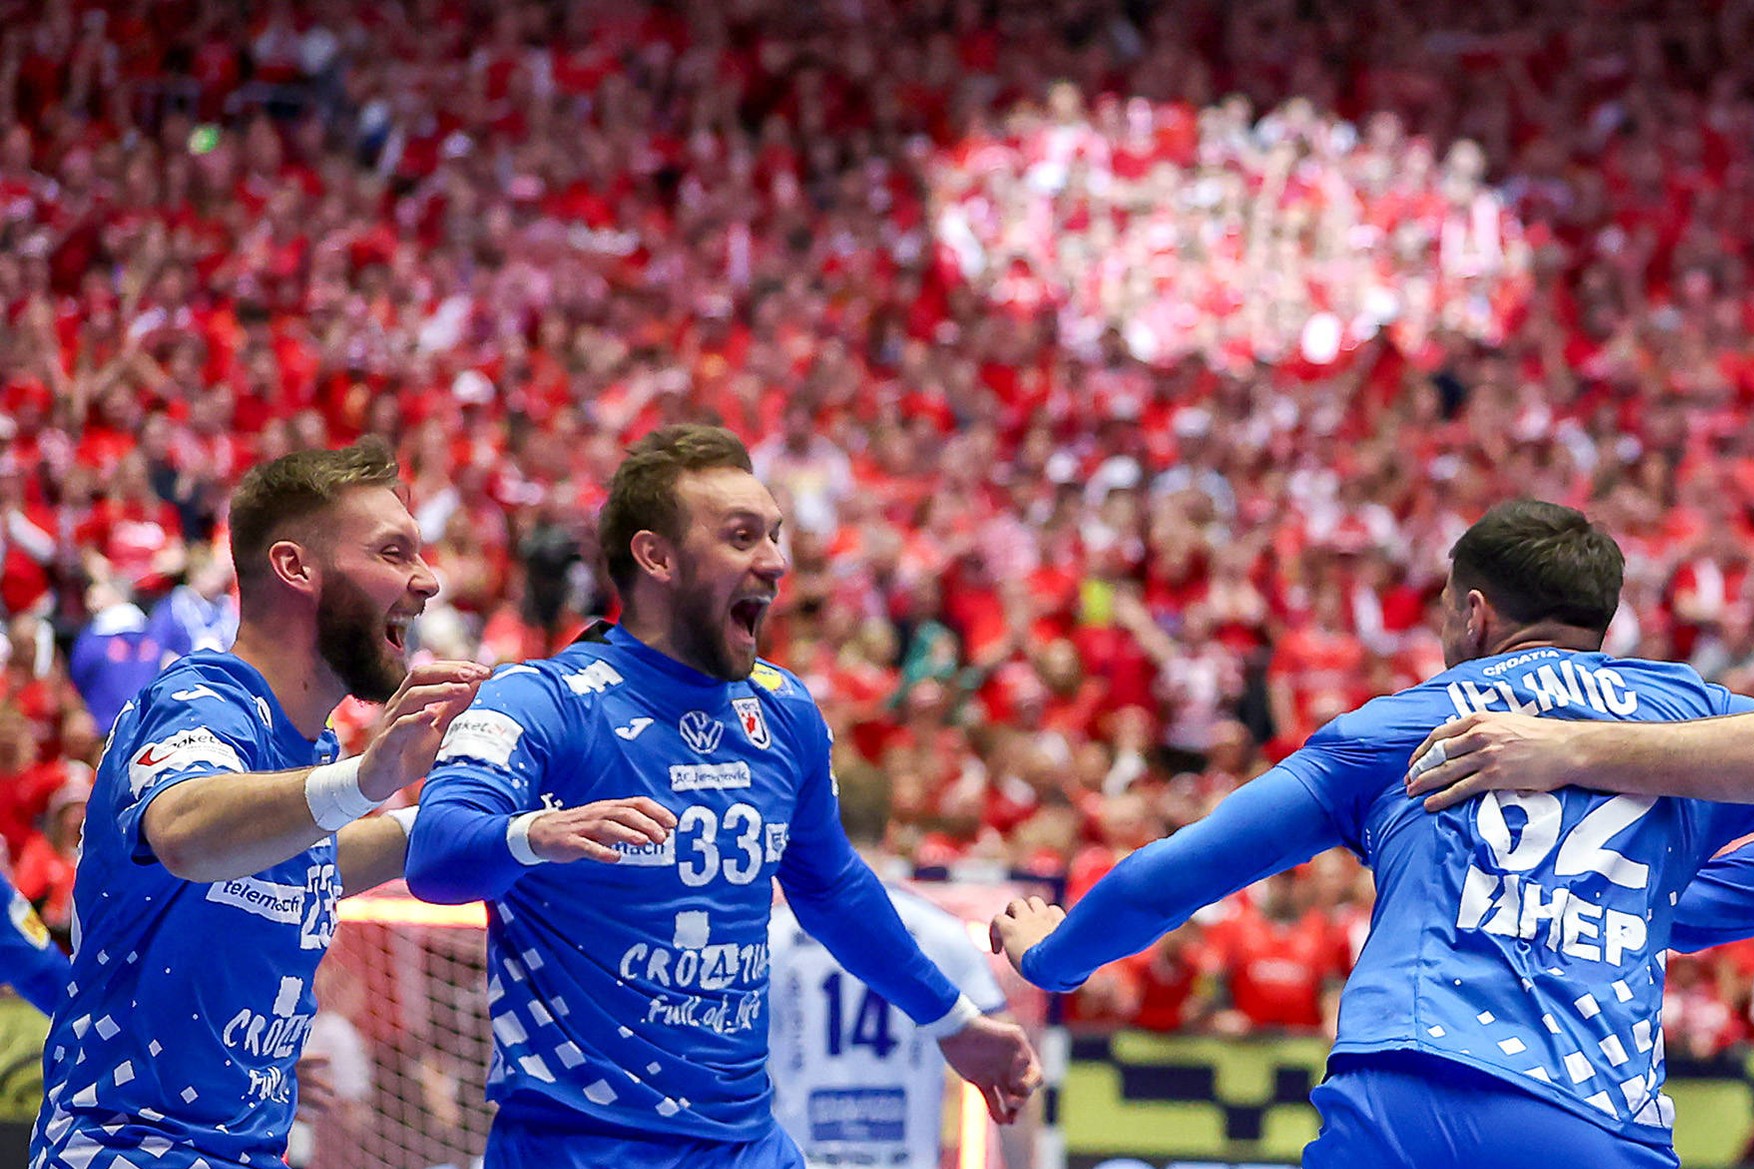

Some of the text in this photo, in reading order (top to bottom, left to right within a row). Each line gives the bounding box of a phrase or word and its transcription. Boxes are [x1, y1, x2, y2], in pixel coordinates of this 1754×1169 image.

[1482, 649, 1560, 677] CROATIA
[678, 803, 762, 887] 33
[301, 864, 339, 950] 23
[1519, 883, 1648, 967] HEP
[821, 971, 900, 1060] 14
